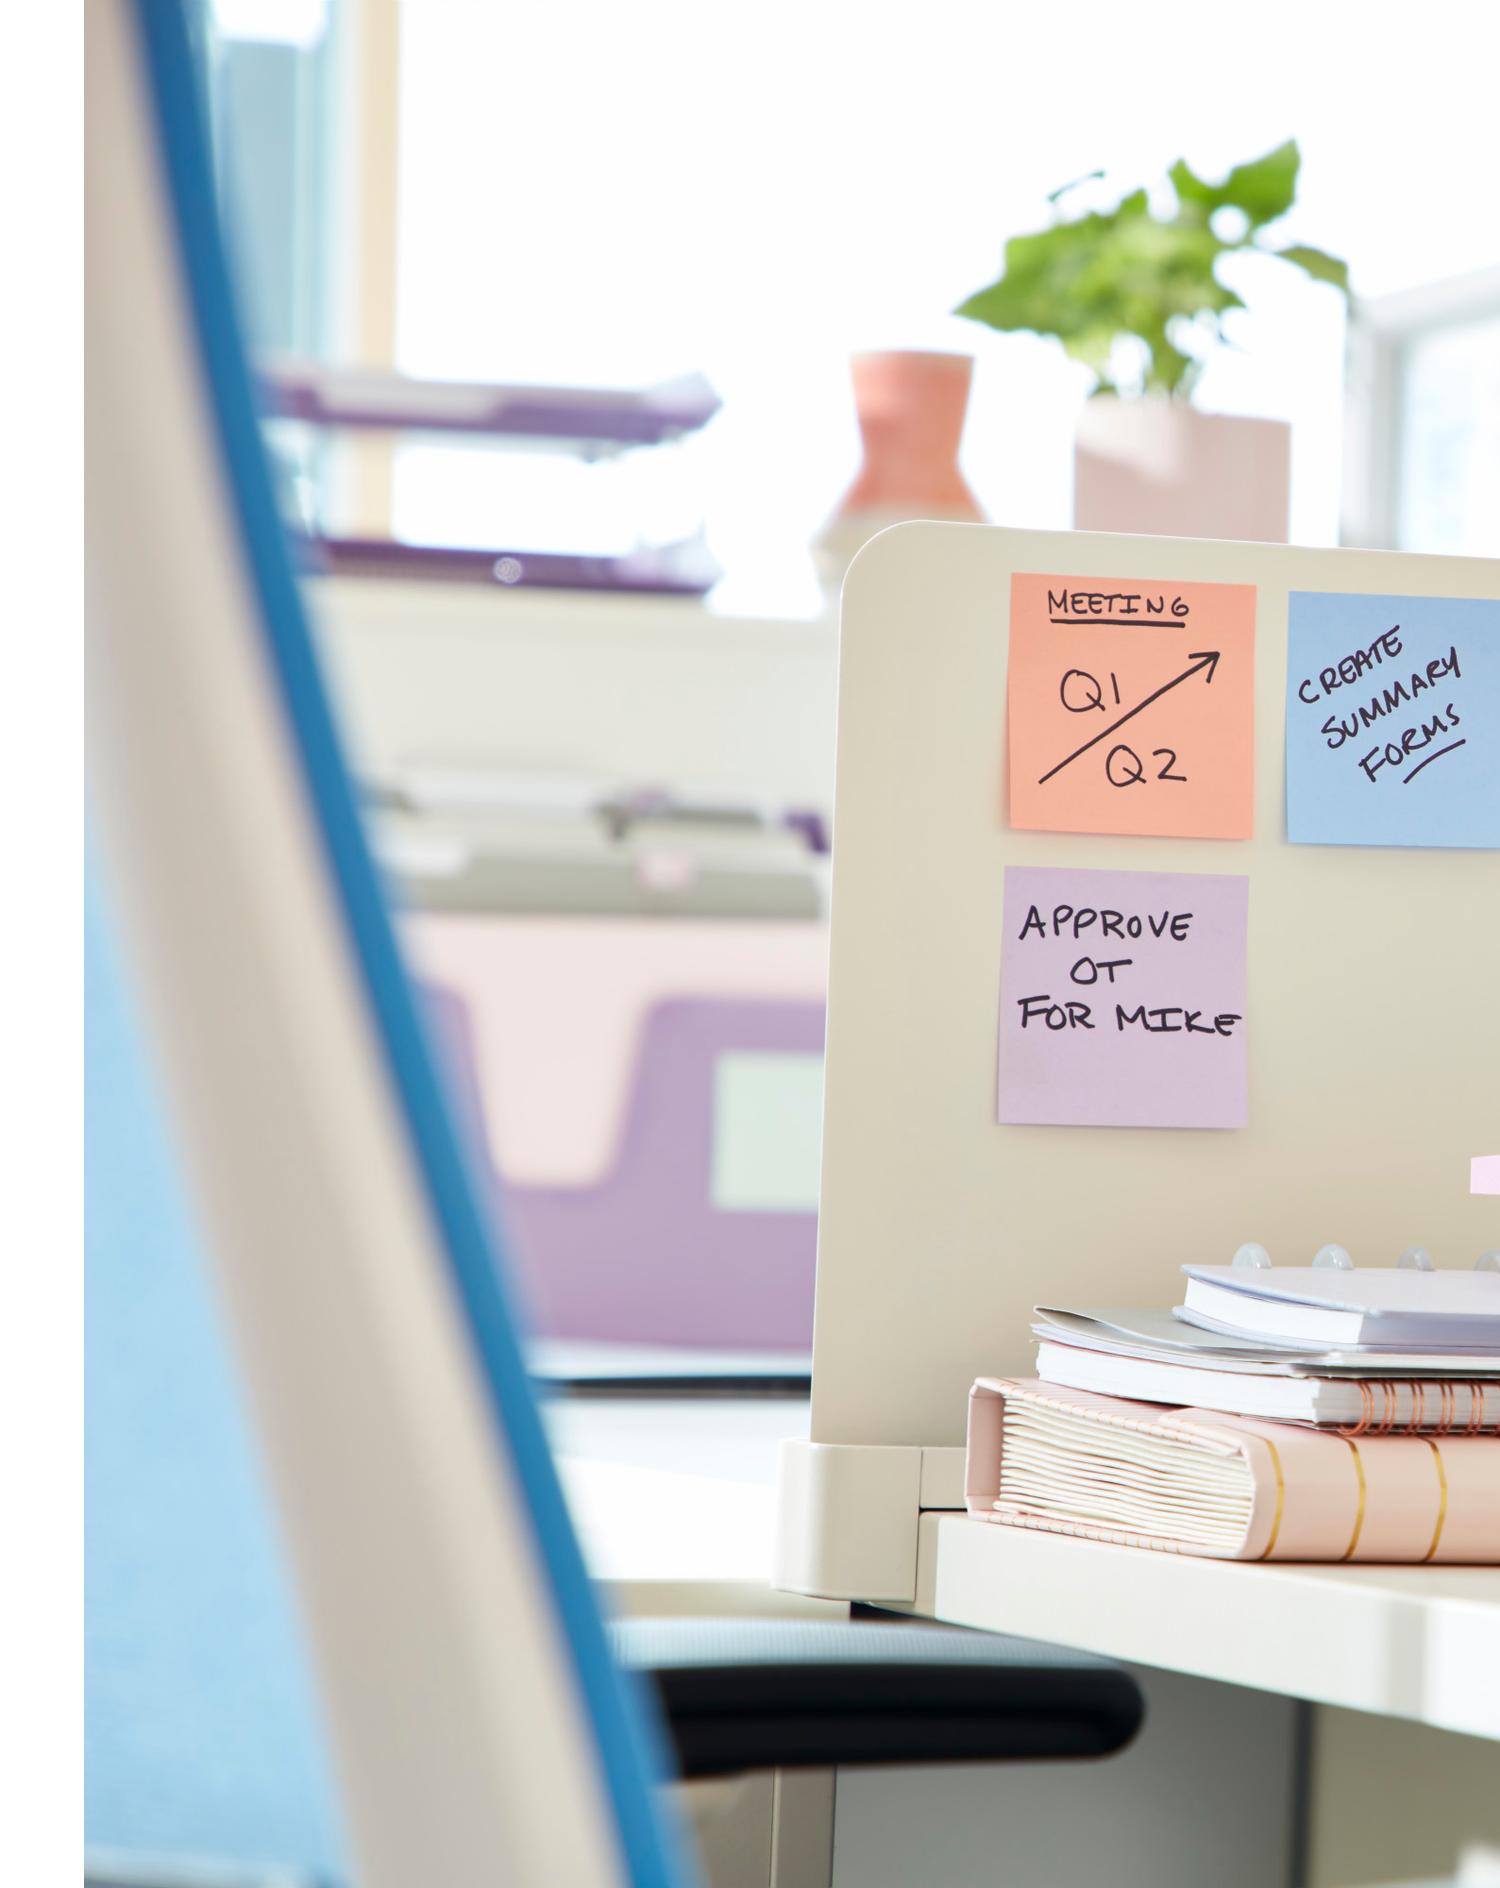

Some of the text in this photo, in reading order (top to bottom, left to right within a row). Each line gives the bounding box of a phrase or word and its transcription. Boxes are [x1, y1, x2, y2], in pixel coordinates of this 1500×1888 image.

[1047, 588, 1190, 617] MEETING
[1297, 624, 1403, 705] CREATE
[1060, 669, 1121, 713] Q1
[1319, 646, 1462, 750] SUMMARY
[1357, 703, 1461, 784] FORMS
[1105, 744, 1188, 788] Q2
[1018, 904, 1194, 942] APPROVE
[1069, 956, 1133, 986] OT
[1017, 994, 1243, 1037] FOR MIKE
